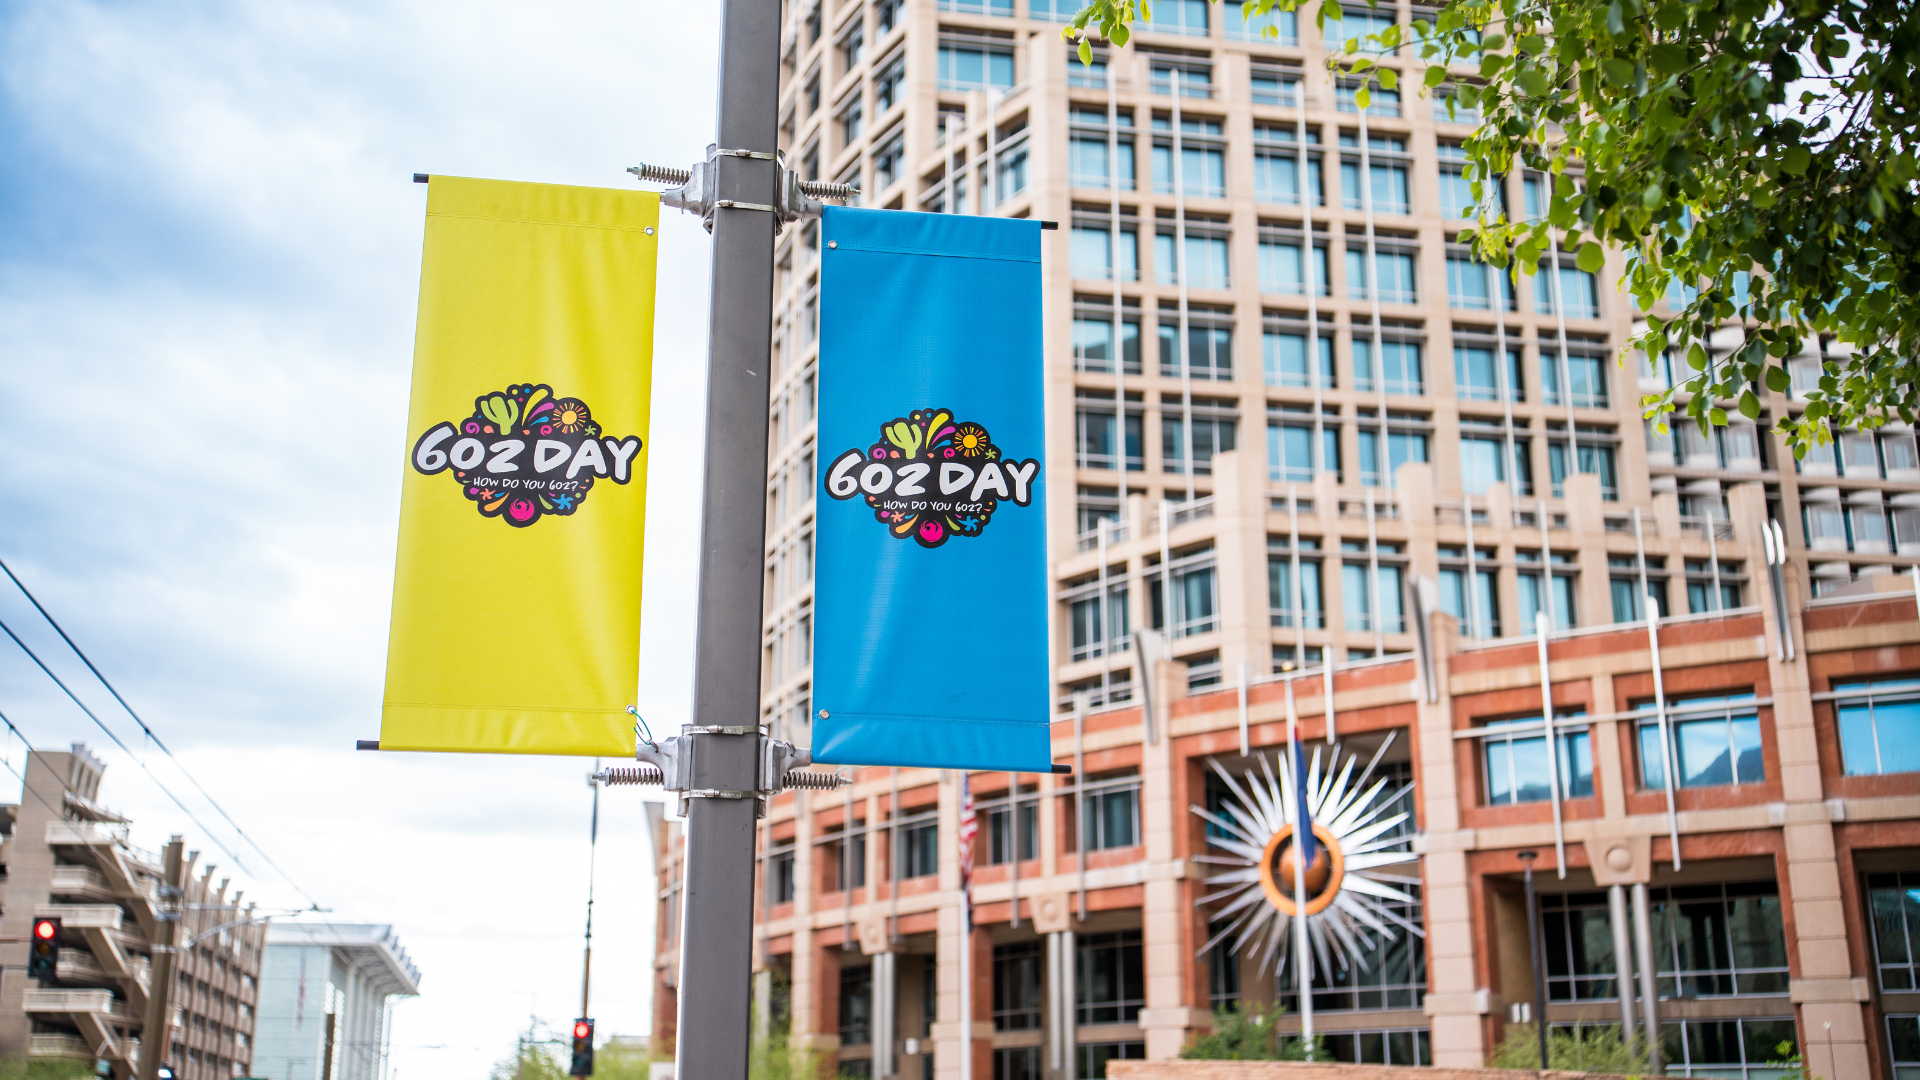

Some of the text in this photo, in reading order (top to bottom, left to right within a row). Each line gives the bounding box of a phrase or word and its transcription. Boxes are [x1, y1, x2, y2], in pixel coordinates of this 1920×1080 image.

[416, 425, 638, 481] 602 DAY
[473, 477, 579, 492] HOW DO YOU 602?
[829, 452, 1036, 502] 602 DAY
[883, 501, 983, 513] HOW DO YOU 602?
